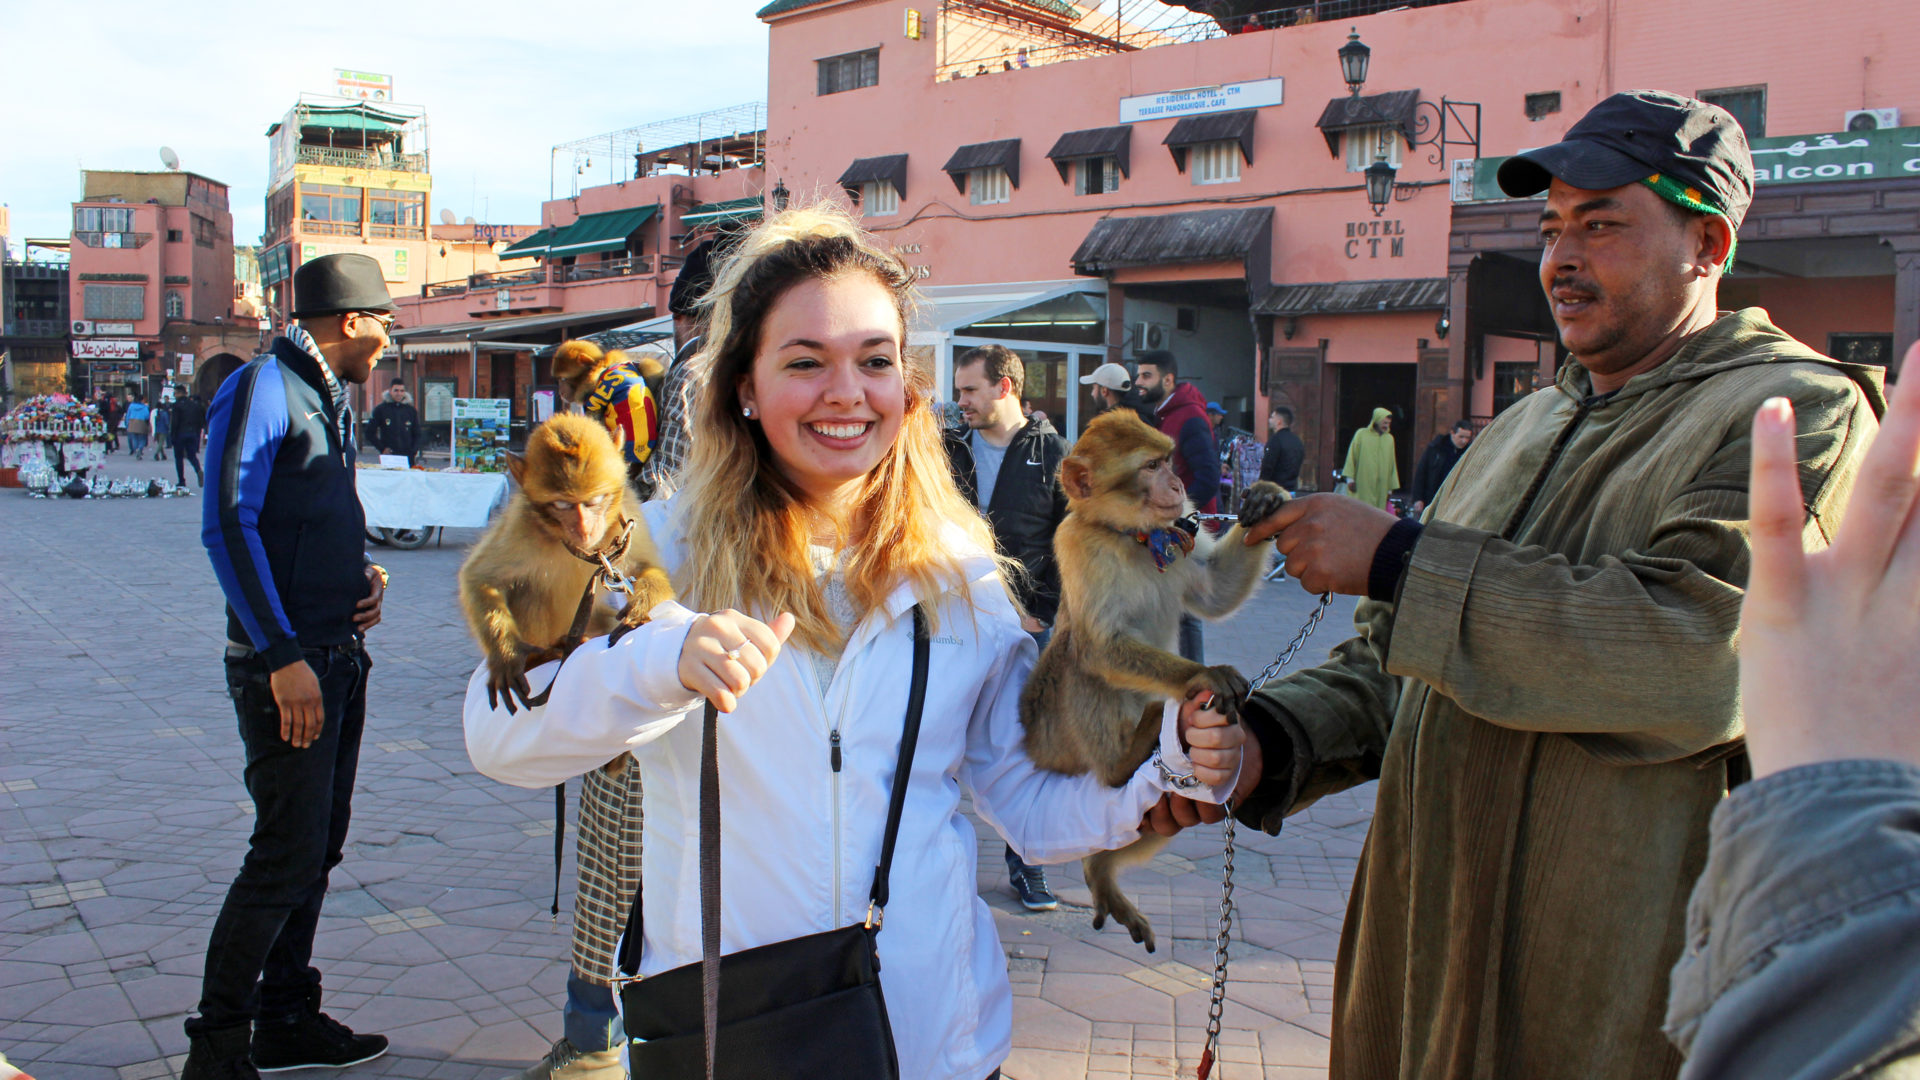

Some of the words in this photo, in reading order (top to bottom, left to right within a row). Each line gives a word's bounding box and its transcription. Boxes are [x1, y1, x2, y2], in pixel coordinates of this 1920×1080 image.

[1156, 93, 1191, 104] RESIDENCE
[1197, 89, 1218, 99] HOTEL
[1227, 87, 1241, 95] CTM
[1166, 101, 1206, 112] PANORAMIQUE
[1754, 162, 1874, 181] alcon
[474, 224, 517, 238] HOTEL
[1346, 219, 1405, 237] HOTEL
